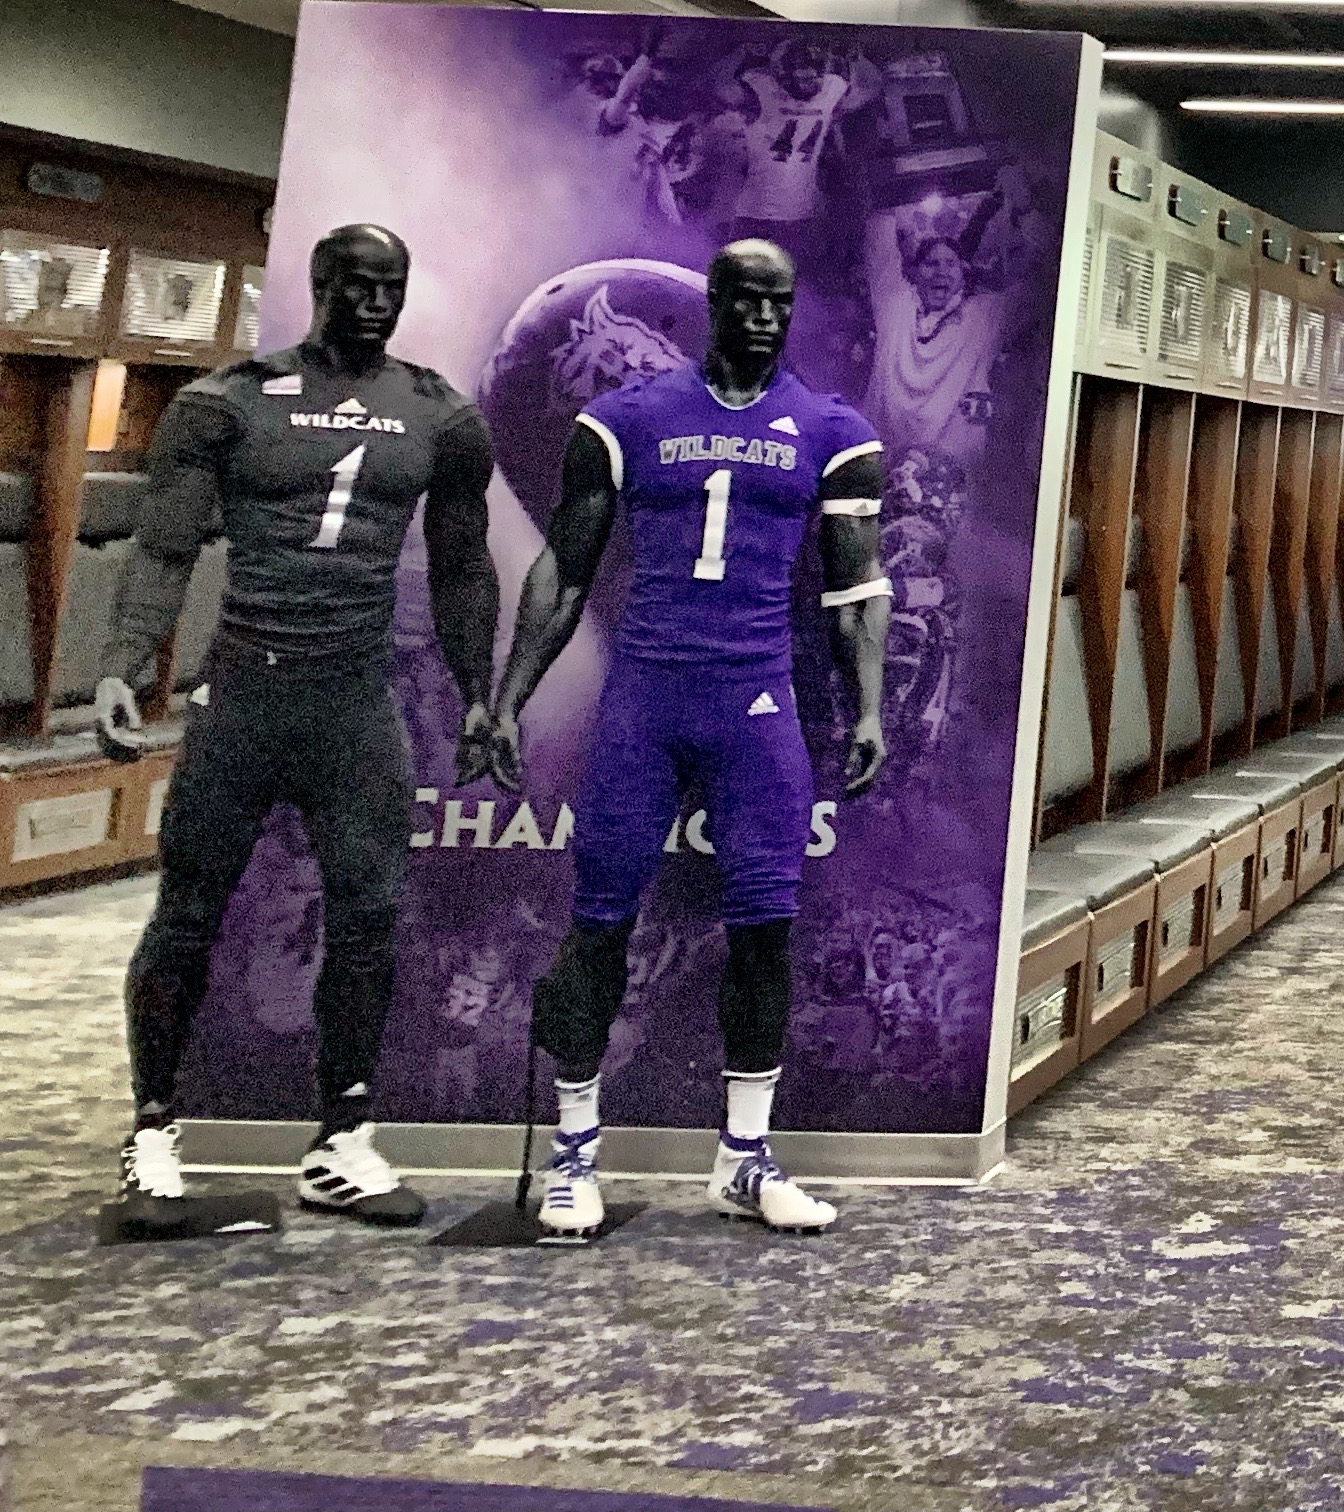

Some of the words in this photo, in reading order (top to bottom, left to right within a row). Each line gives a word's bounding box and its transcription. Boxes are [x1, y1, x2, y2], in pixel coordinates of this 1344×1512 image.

[289, 412, 406, 435] WILDCATS
[658, 434, 798, 471] WILDCATS
[307, 441, 368, 549] 1
[692, 468, 733, 581] 1
